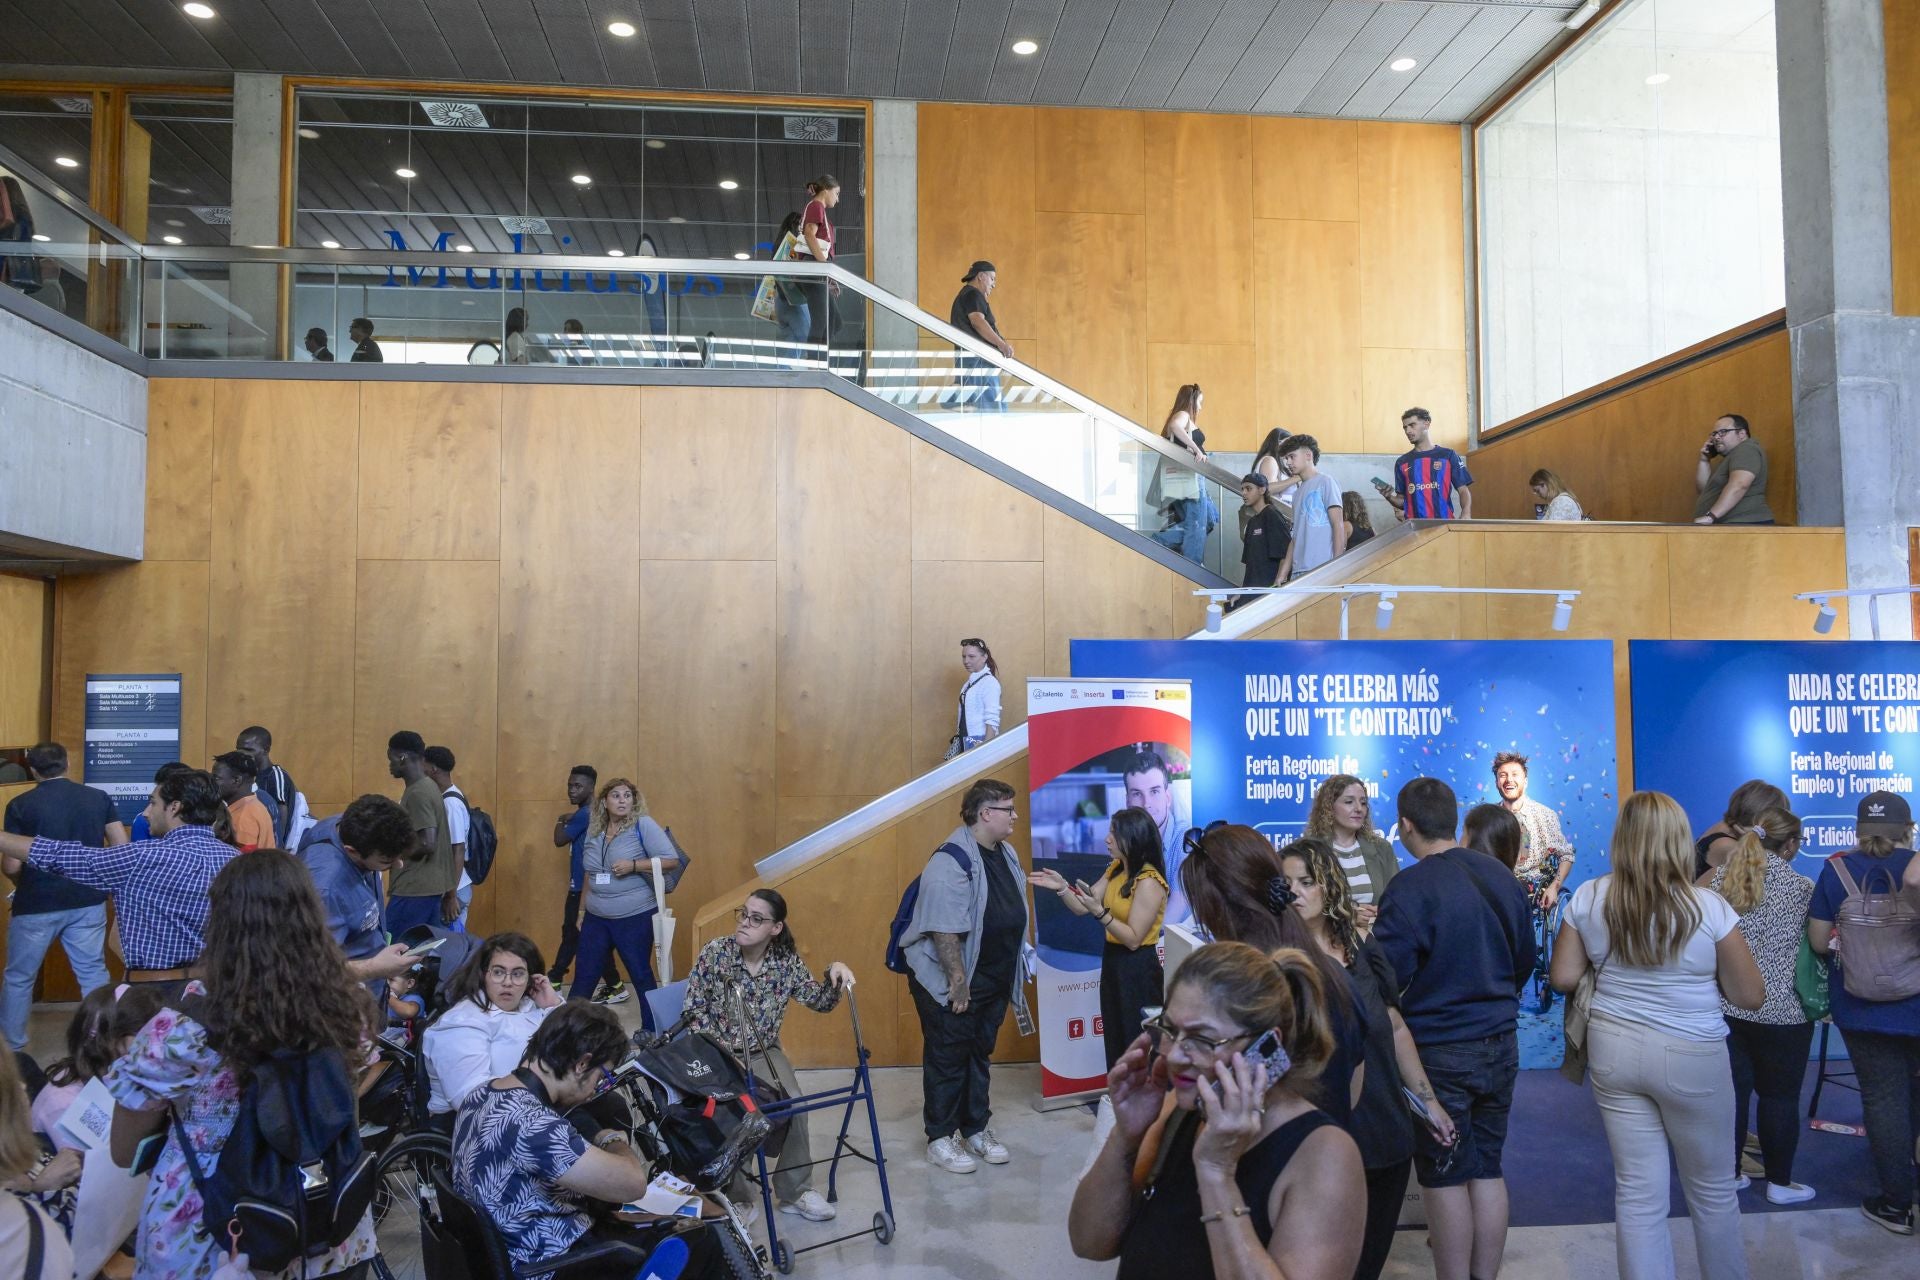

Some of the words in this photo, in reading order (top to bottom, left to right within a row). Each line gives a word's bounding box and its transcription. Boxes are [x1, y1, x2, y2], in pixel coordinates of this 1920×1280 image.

[1245, 674, 1293, 703] NADA
[1297, 674, 1319, 703] SE
[1322, 674, 1398, 703] CELEBRA
[1402, 667, 1440, 703] MÁS
[1788, 673, 1833, 701] NADA
[1836, 673, 1856, 701] SE
[1246, 707, 1280, 741] QUE
[1285, 707, 1309, 737] UN
[1314, 707, 1346, 737] "TE
[1350, 707, 1452, 737] CONTRATO"
[1789, 706, 1822, 737] QUE
[1825, 706, 1848, 733] UN
[1852, 705, 1881, 733] "TE
[1884, 705, 1920, 733] CON
[1246, 755, 1279, 775] Feria
[1283, 755, 1339, 780] Regional
[1342, 755, 1359, 775] de
[1791, 751, 1822, 771] Feria
[1824, 751, 1876, 775] Regional
[1879, 751, 1893, 771] de
[1246, 779, 1293, 804] Empleo
[1295, 783, 1304, 804] y
[1791, 774, 1834, 798] Empleo
[1837, 778, 1845, 798] y
[1850, 772, 1912, 793] Formación
